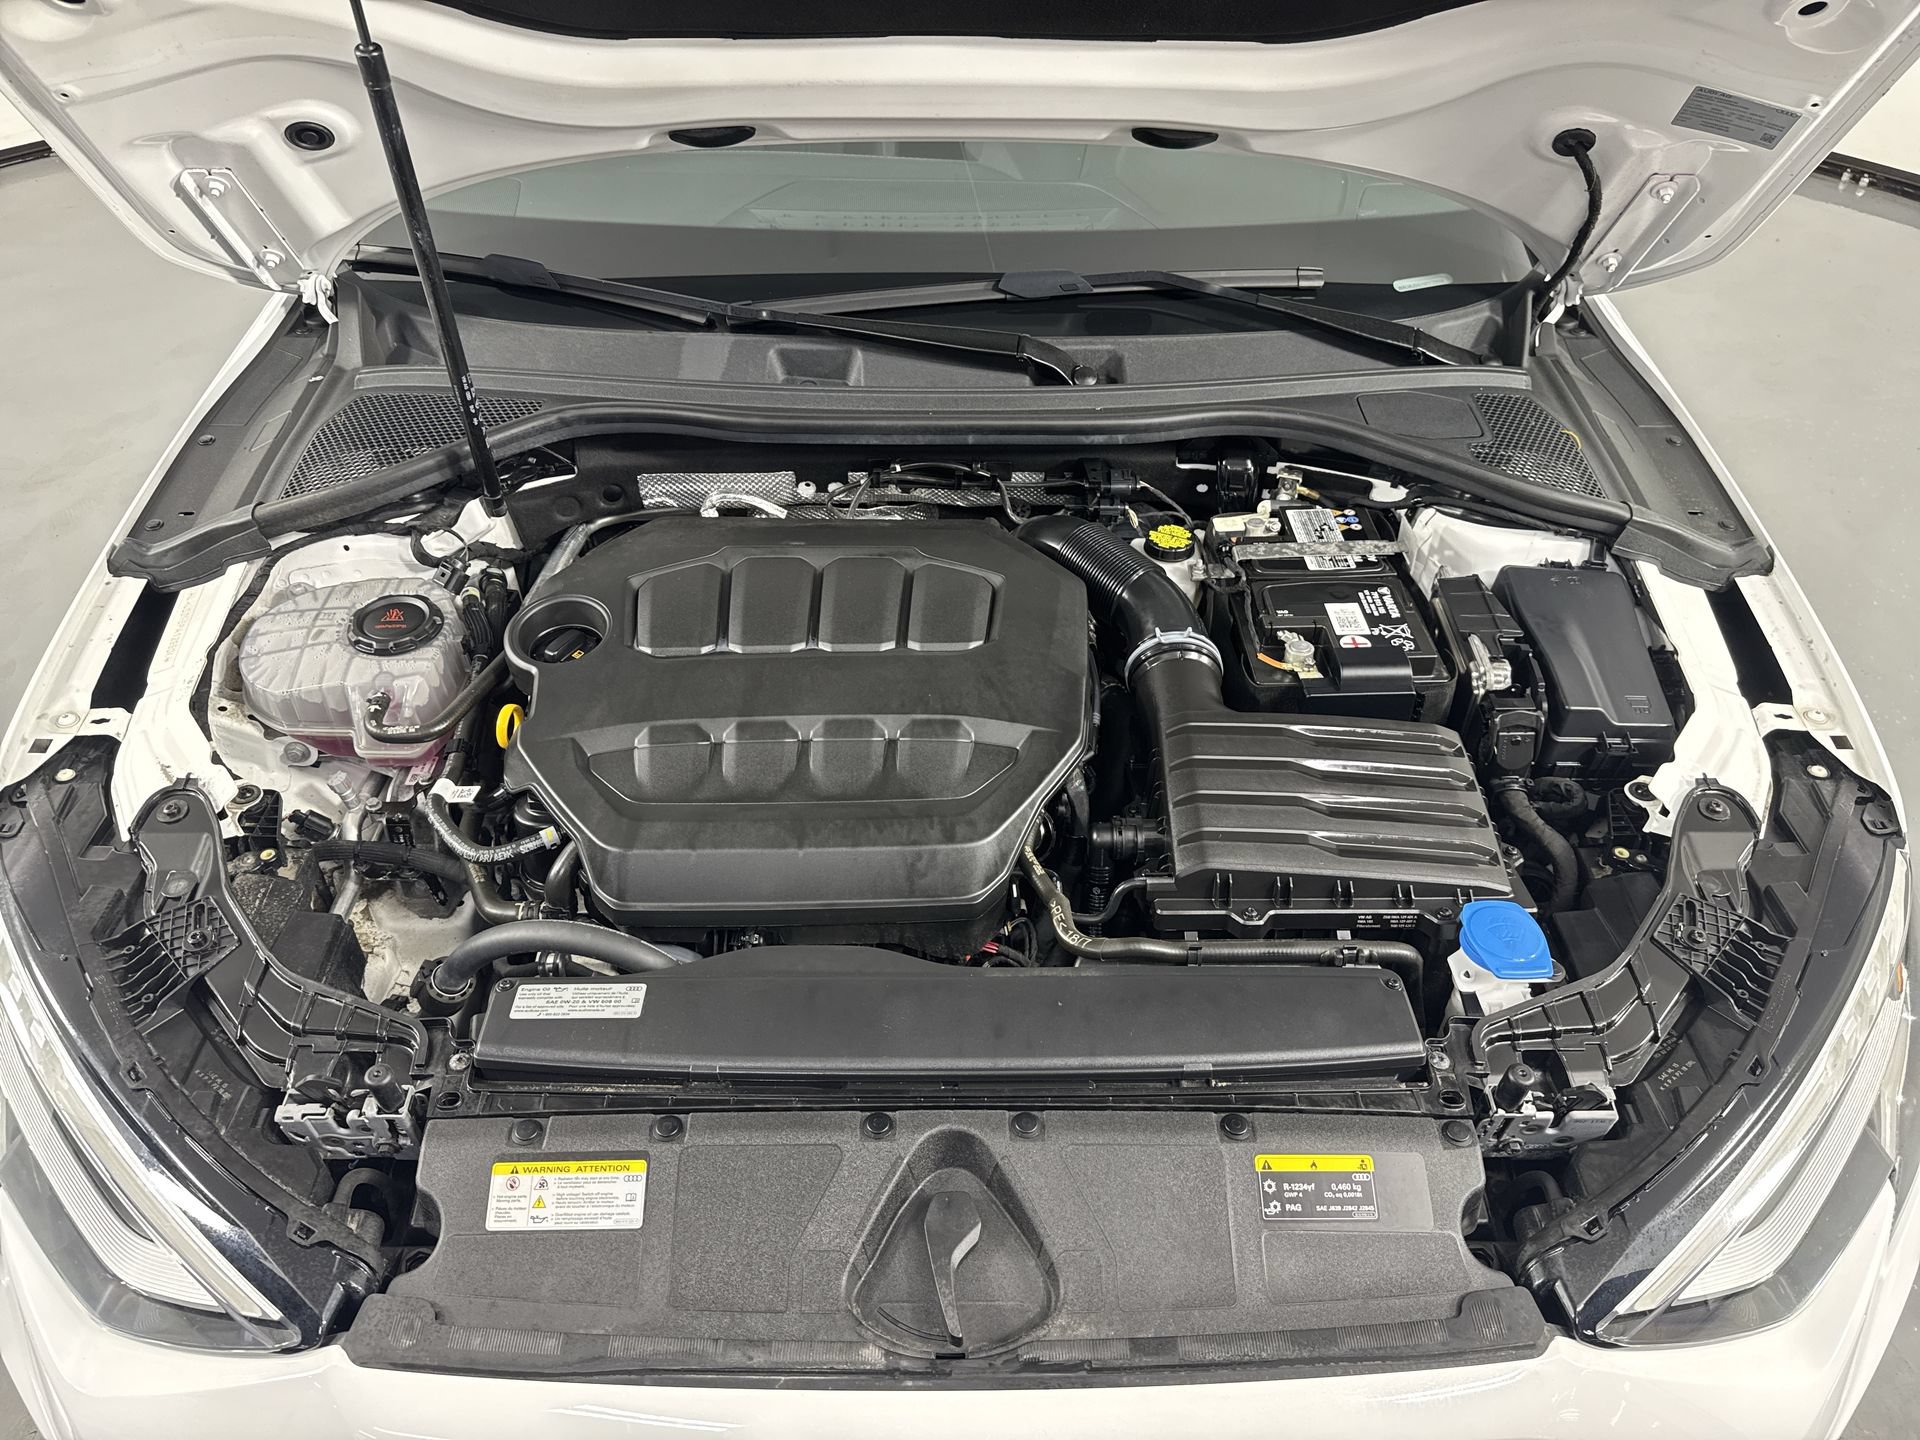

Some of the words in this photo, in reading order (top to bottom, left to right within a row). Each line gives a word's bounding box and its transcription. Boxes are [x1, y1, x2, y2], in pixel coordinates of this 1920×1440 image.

[1382, 594, 1400, 618] VARTA
[1283, 1183, 1315, 1192] R-1234yf
[1331, 1183, 1351, 1192] 0,460
[1352, 1183, 1361, 1192] kg
